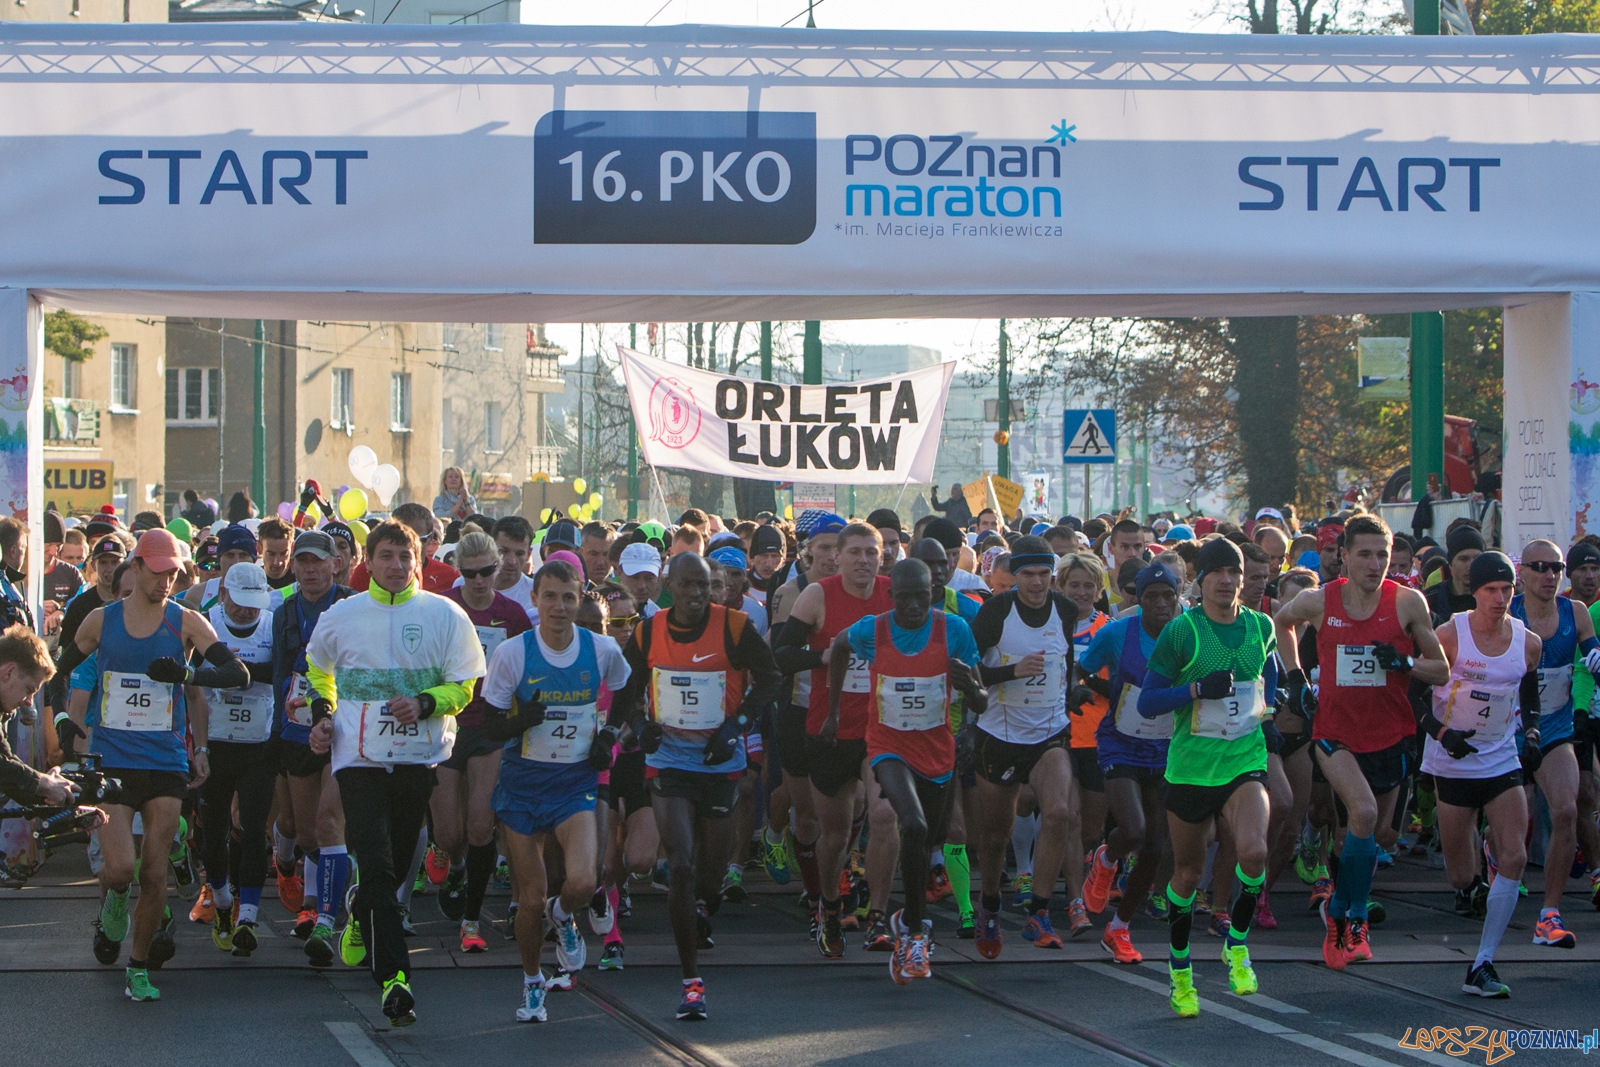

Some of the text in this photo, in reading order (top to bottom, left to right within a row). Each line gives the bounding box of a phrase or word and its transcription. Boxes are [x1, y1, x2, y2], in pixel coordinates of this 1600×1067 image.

[98, 149, 368, 205] START
[558, 150, 792, 203] 16. PKO
[1238, 156, 1500, 212] START
[845, 176, 1062, 217] maraton
[876, 222, 944, 239] Macieja
[952, 222, 1063, 237] Frankiewicza
[666, 435, 683, 445] 1923
[1518, 485, 1544, 512] SPEED
[847, 657, 870, 671] 22
[1351, 659, 1376, 675] 29
[1025, 673, 1047, 687] 22
[125, 692, 151, 708] 46
[533, 688, 592, 703] UKRAINE
[680, 691, 699, 706] 15
[902, 696, 926, 710] 55
[229, 708, 252, 722] 58
[1229, 701, 1239, 717] 3
[1478, 706, 1491, 719] 4
[378, 720, 419, 736] 7143
[551, 725, 577, 740] 42
